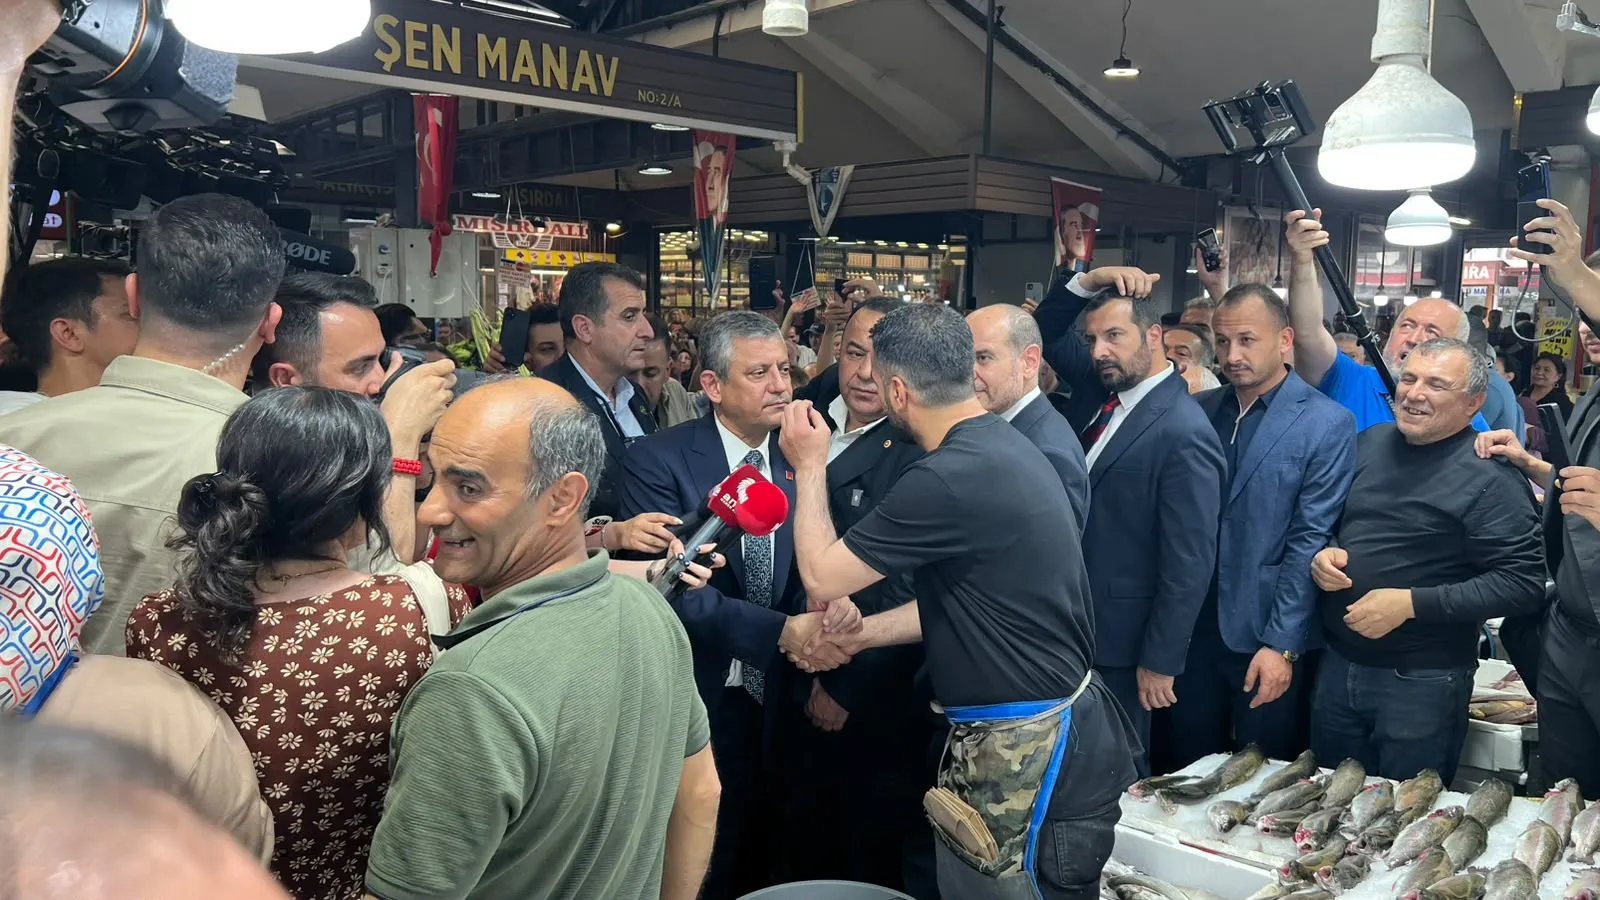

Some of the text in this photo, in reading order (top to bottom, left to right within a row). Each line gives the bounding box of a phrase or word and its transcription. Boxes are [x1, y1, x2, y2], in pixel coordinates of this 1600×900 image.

[374, 14, 619, 97] ŞEN MANAV
[638, 90, 682, 108] NO:2/A
